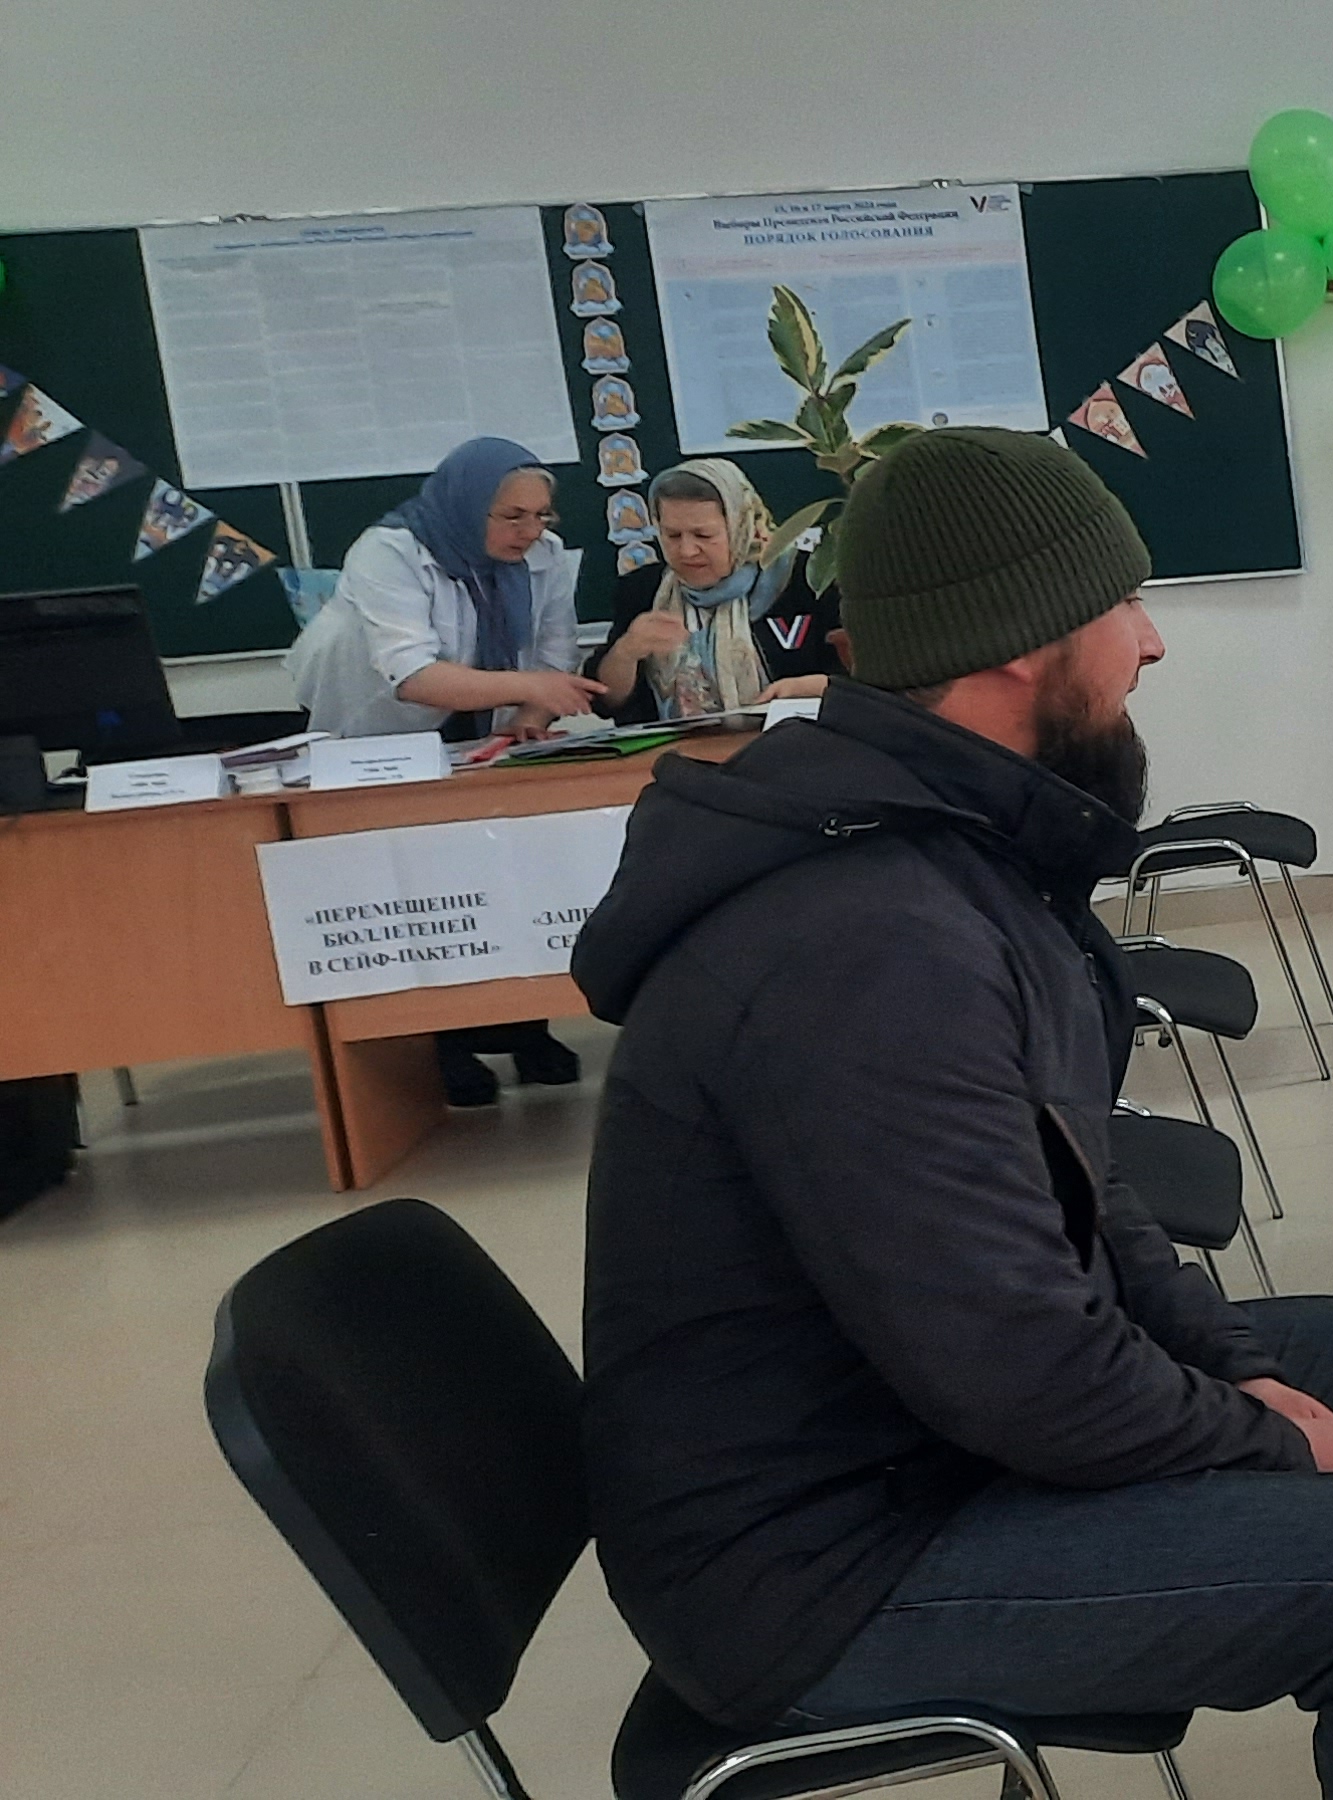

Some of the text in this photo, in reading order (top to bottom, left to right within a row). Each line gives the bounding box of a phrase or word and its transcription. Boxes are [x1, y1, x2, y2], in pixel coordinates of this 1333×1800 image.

[744, 226, 934, 245] ПОРЯДОК ГОЛОСОВАНИЯ
[322, 914, 478, 948] БЮЛЛЕТЕНЕЙ
[307, 960, 323, 976] В
